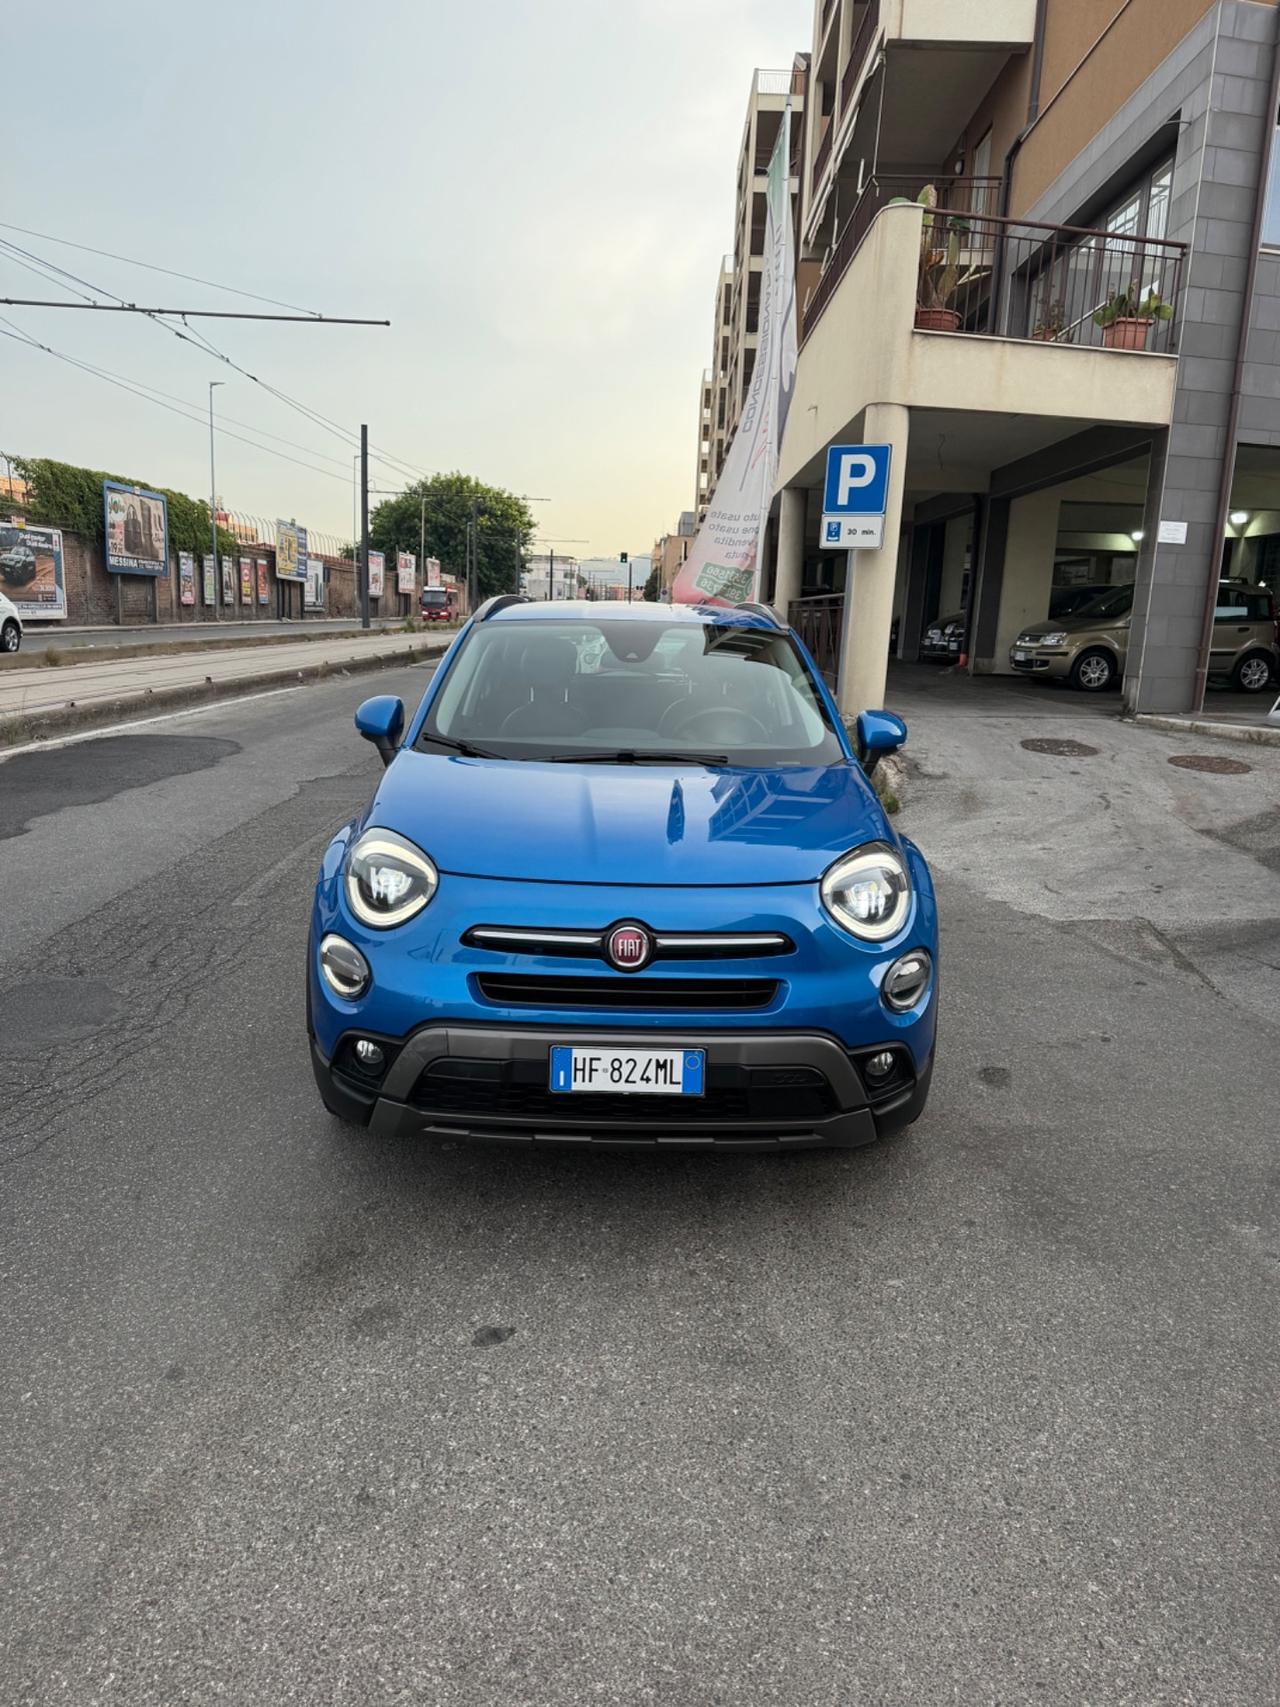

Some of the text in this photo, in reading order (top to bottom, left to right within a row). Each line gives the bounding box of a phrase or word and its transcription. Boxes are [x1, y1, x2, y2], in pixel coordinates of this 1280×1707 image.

[837, 454, 876, 506] P
[847, 528, 877, 536] 30 min.
[109, 555, 139, 568] MESSINA
[618, 939, 641, 957] FIAT
